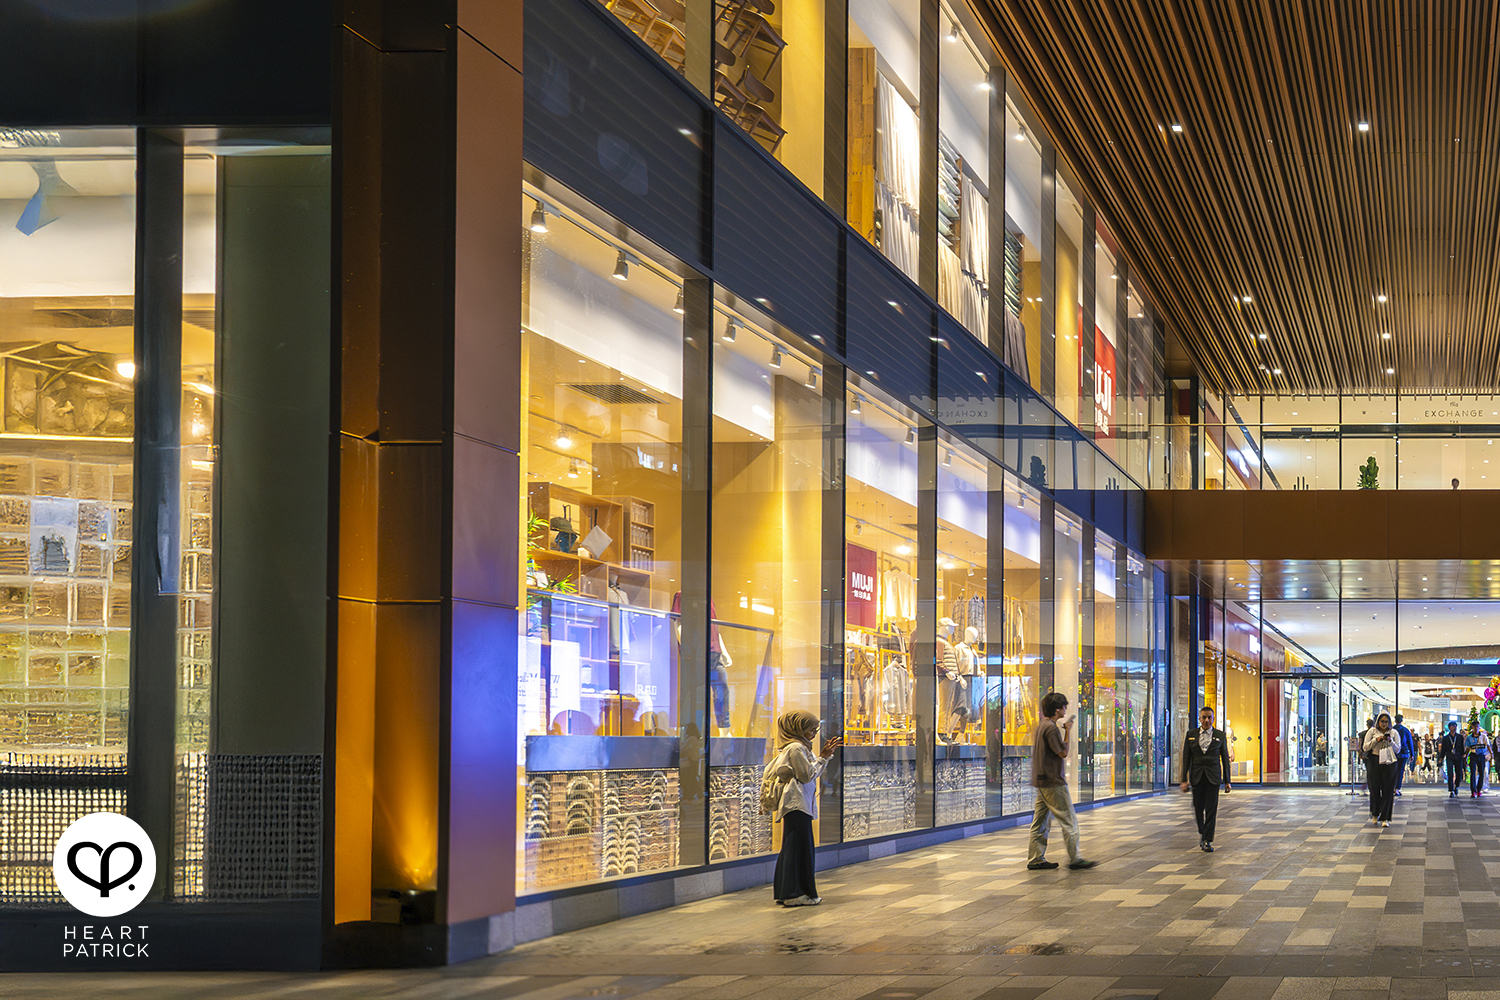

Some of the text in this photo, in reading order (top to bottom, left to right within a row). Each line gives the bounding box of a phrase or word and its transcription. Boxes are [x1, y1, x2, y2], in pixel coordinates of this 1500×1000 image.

[1094, 360, 1112, 417] UJI
[1424, 409, 1484, 418] EXCHANGE
[851, 571, 874, 593] MUJI
